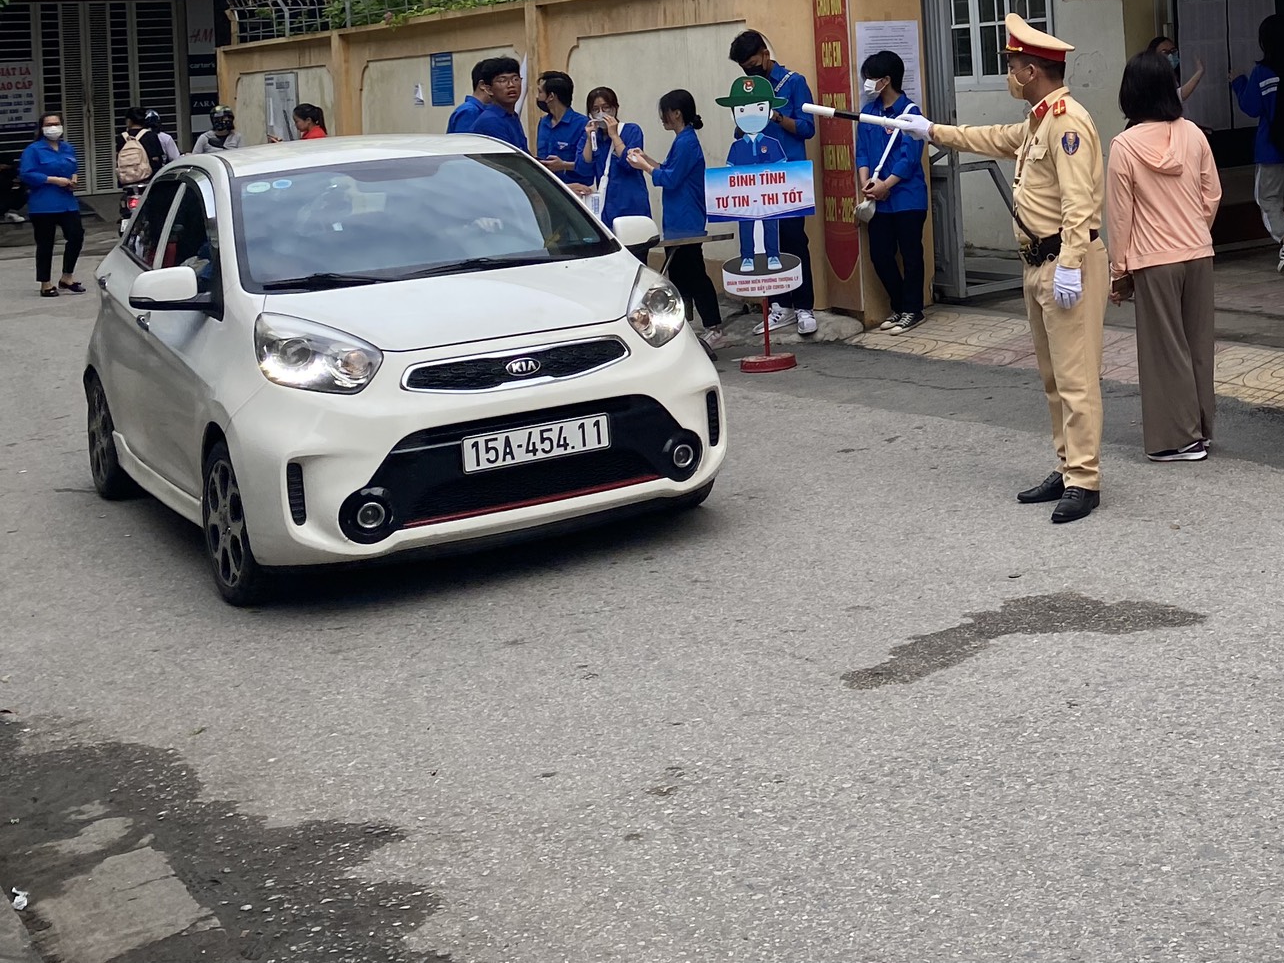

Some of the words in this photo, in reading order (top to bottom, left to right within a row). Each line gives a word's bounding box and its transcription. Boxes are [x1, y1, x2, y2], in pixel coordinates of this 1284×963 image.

[729, 173, 756, 188] BÌNH
[759, 169, 786, 187] TĨNH
[716, 195, 730, 211] TỰ
[732, 194, 750, 208] TIN
[761, 191, 779, 205] THI
[782, 187, 804, 205] TỐT
[511, 359, 538, 375] KIA
[470, 419, 604, 469] 15A-454.11
